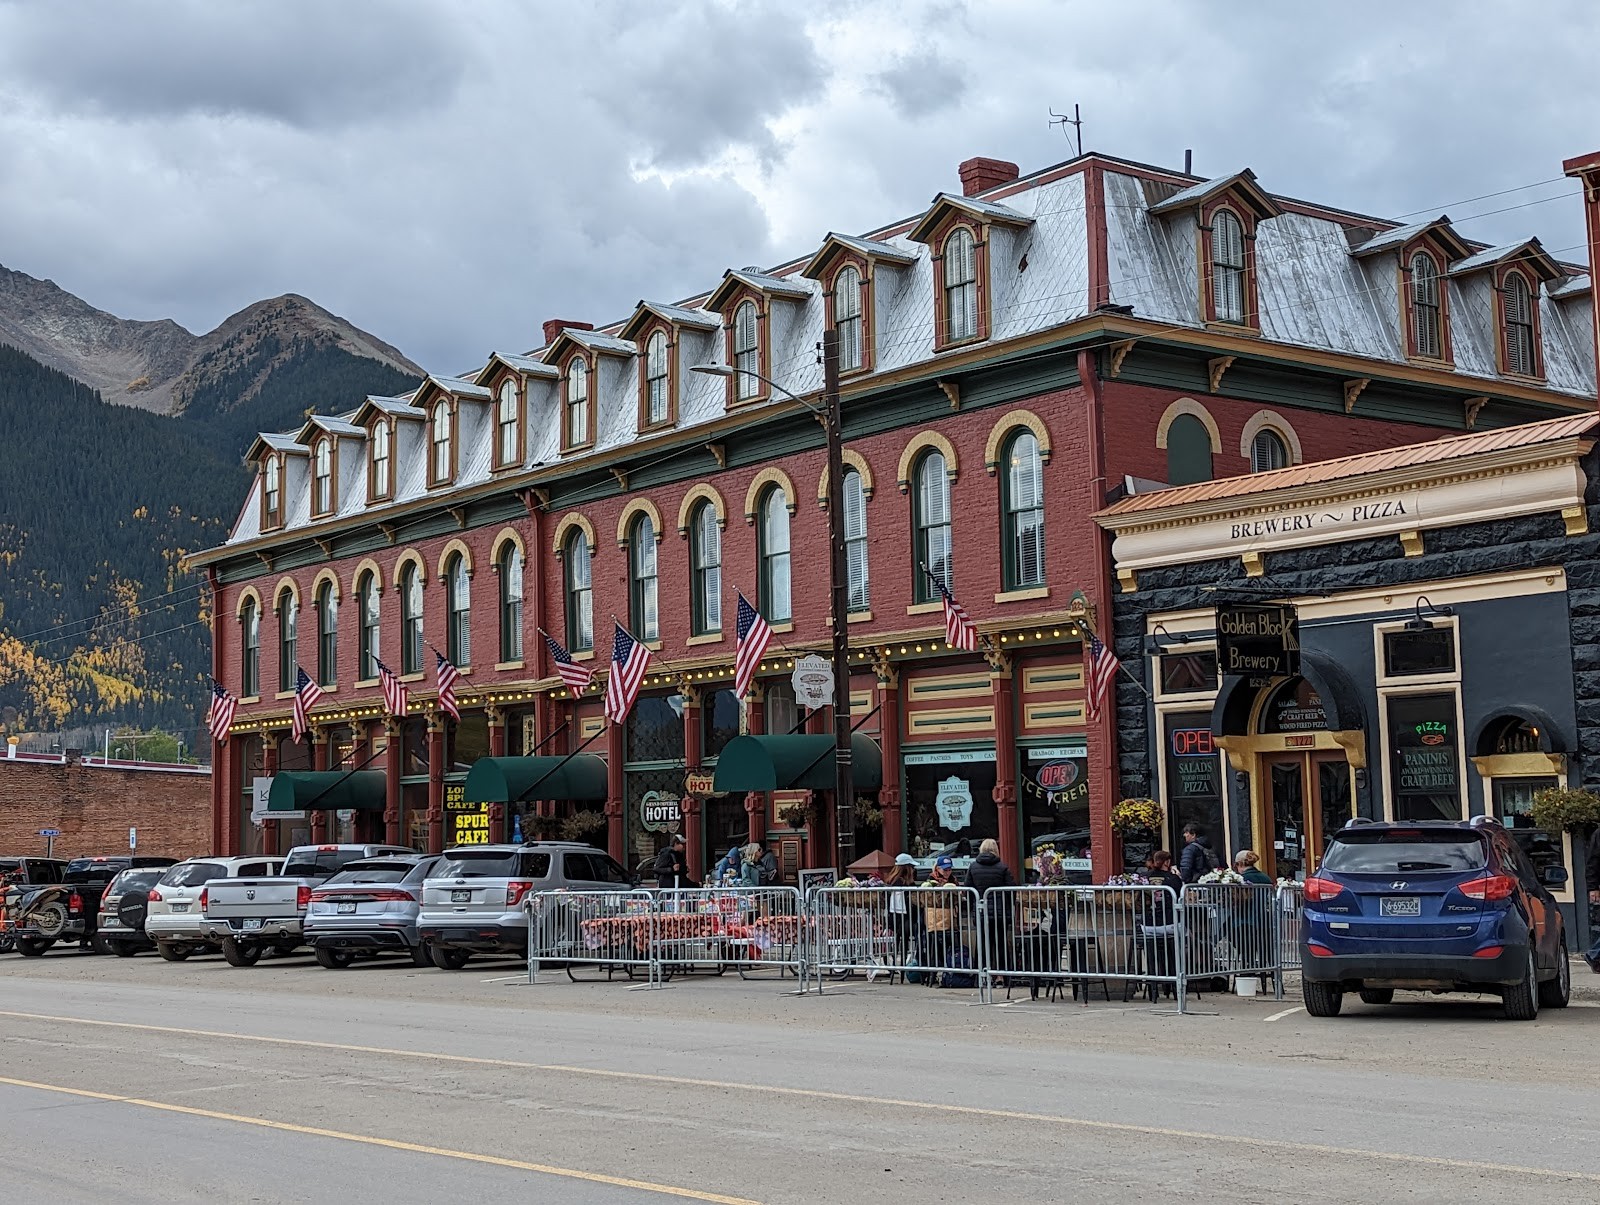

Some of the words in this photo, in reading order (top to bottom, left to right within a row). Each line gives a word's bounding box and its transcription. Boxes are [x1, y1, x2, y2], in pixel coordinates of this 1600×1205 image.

[1231, 512, 1317, 539] BREWERY
[1351, 500, 1407, 522] PIZZA
[1220, 612, 1257, 635] Golden
[1258, 609, 1300, 651] Block
[1230, 646, 1280, 672] Brewery
[1415, 721, 1447, 735] PIZZA
[1404, 751, 1449, 766] PANINIS
[1178, 760, 1213, 774] SALADS
[1183, 781, 1210, 792] PIZZA
[1401, 773, 1430, 787] CRAFT
[1431, 772, 1456, 786] BEER
[646, 806, 681, 821] HOTEL
[455, 814, 490, 829] SPUR
[455, 830, 489, 845] CAFE
[121, 904, 144, 912] HONDA
